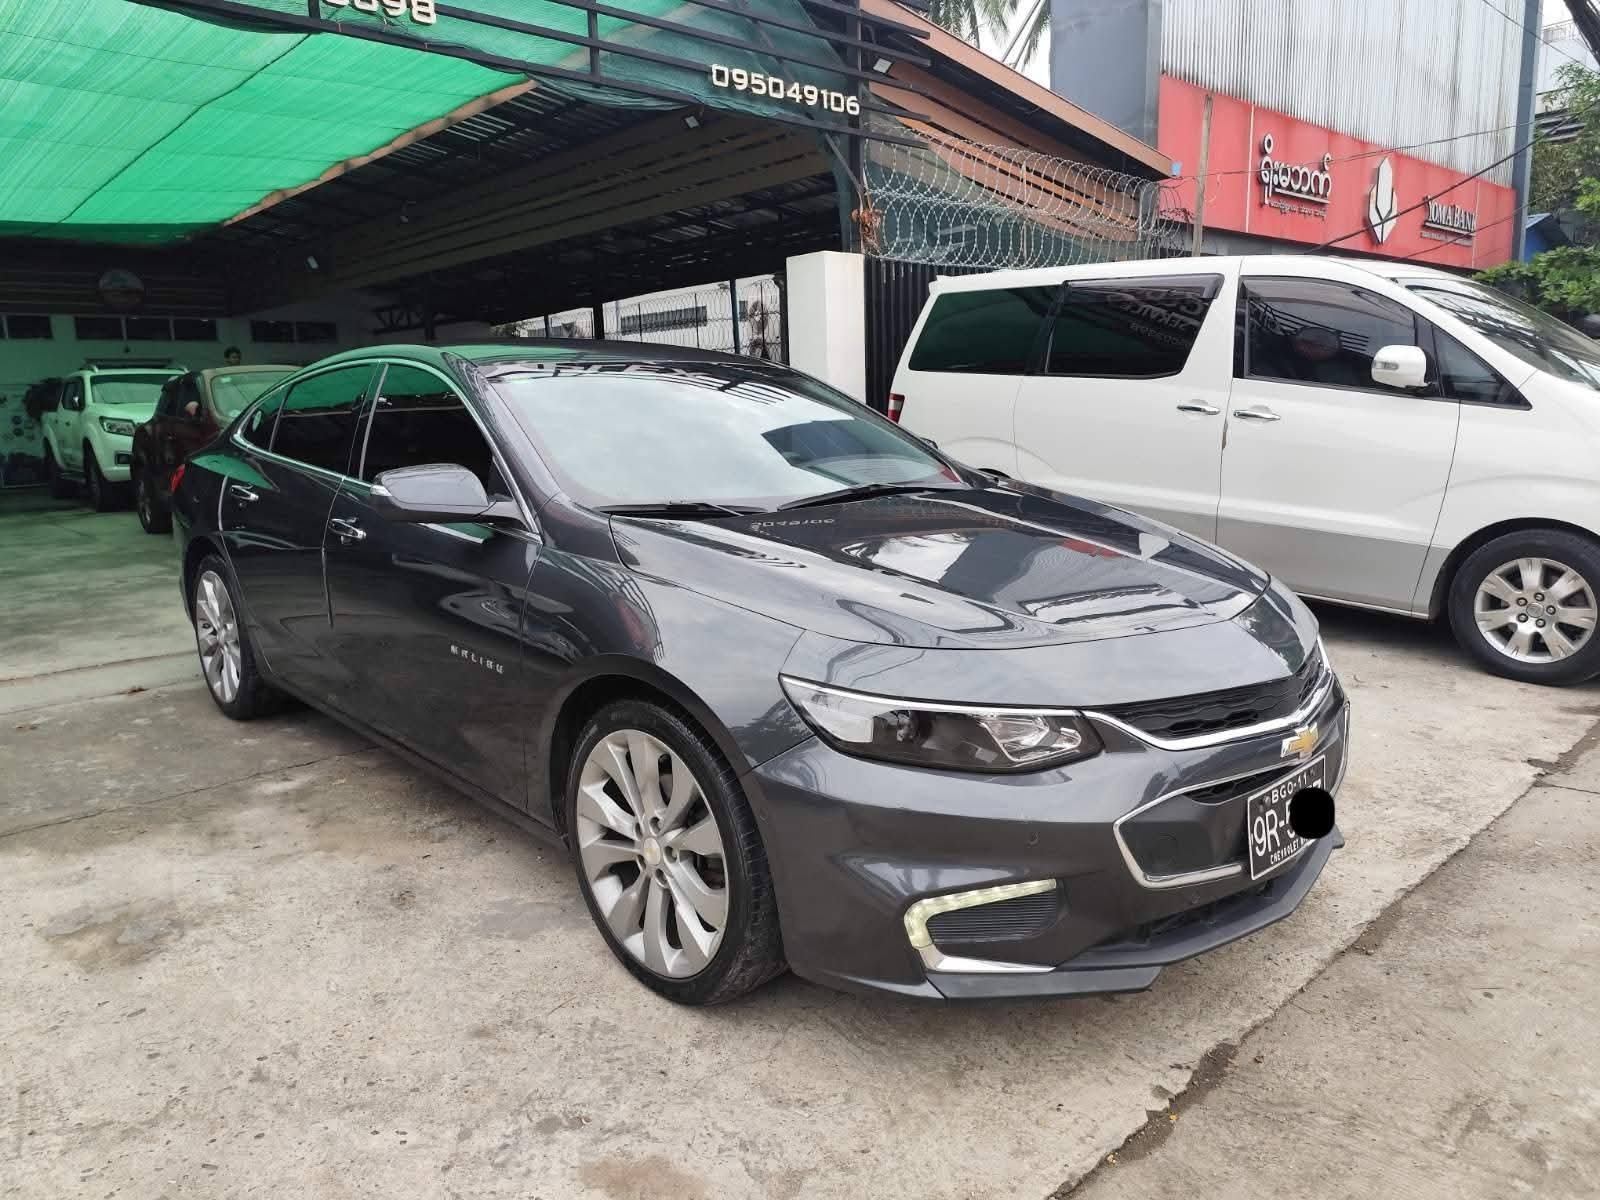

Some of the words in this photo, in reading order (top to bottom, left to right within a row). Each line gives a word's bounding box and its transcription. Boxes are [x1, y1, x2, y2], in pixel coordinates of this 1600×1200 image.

[322, 0, 437, 24] 98
[711, 63, 860, 116] 095049106
[1427, 195, 1453, 227] YOMA
[1453, 204, 1477, 232] BANK
[1270, 837, 1299, 865] CHEVROLET
